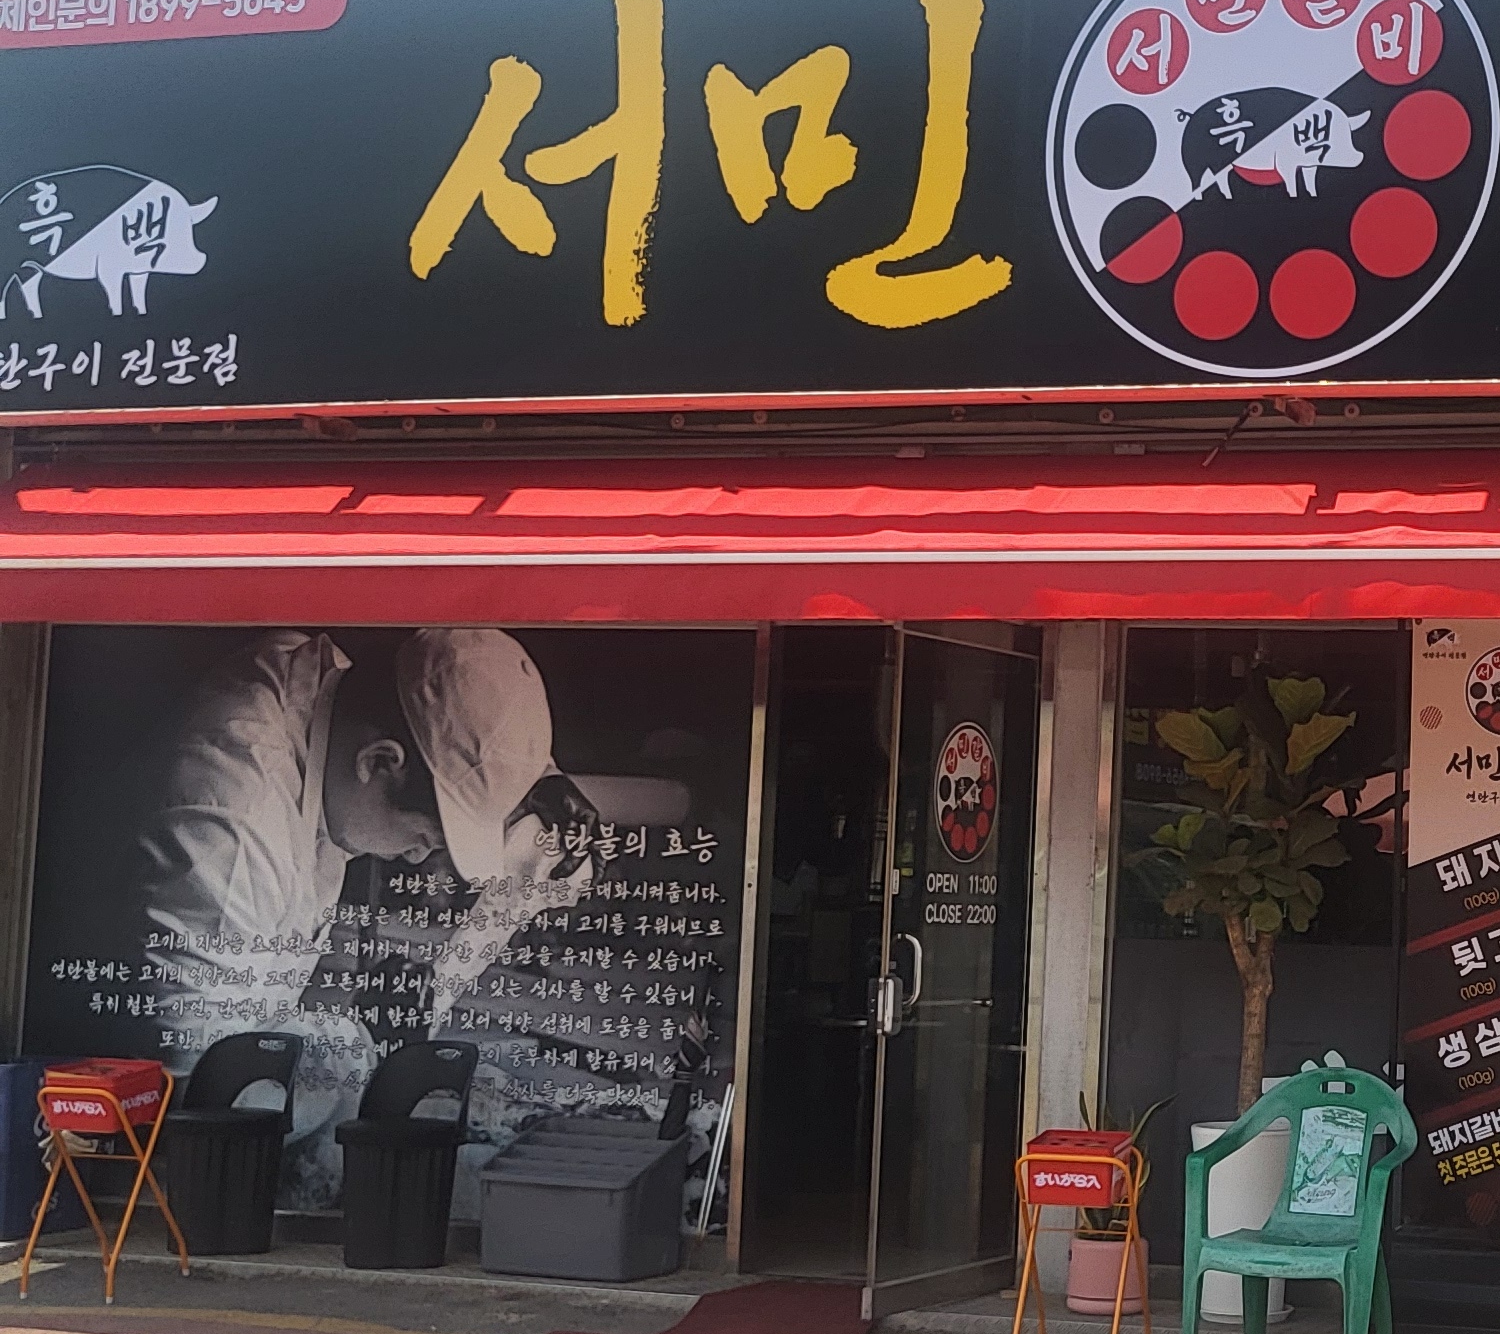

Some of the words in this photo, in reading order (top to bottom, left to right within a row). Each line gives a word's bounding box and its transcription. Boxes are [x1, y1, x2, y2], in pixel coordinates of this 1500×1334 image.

[120, 333, 239, 387] 전문점
[534, 822, 647, 859] 연탄불의
[661, 825, 720, 863] 효능
[389, 872, 459, 896] 연탄불은
[926, 872, 959, 895] OPEN
[968, 874, 998, 896] 11:00
[925, 903, 963, 925] CLOSE
[966, 904, 997, 925] 22:00
[1463, 887, 1500, 912] (100g)
[322, 903, 391, 927] 연탄불은
[399, 905, 431, 929] 직접
[576, 911, 627, 937] 고기를
[634, 914, 725, 938] 구워내므로
[145, 931, 191, 952] 고기의
[343, 937, 412, 960] 제거하여
[560, 944, 615, 970] 유지할
[621, 948, 640, 970] 수
[51, 957, 132, 982] 연탄불에는
[137, 963, 183, 984] 고기의
[319, 971, 385, 993] 보존되어
[392, 971, 422, 994] 있어
[490, 975, 523, 998] 있는
[529, 977, 586, 1002] 식사를
[593, 980, 612, 1005] 할
[619, 982, 638, 1005] 수
[1460, 978, 1497, 1001] (100g)
[88, 992, 120, 1016] 특히
[459, 1007, 491, 1031] 있어
[498, 1009, 534, 1034] 영양
[599, 1014, 652, 1040] 도움을
[1458, 1066, 1496, 1091] (100g)
[1033, 1171, 1102, 1190] すいがら入
[1436, 1160, 1458, 1186] 첫
[1453, 1146, 1495, 1180] 주문은
